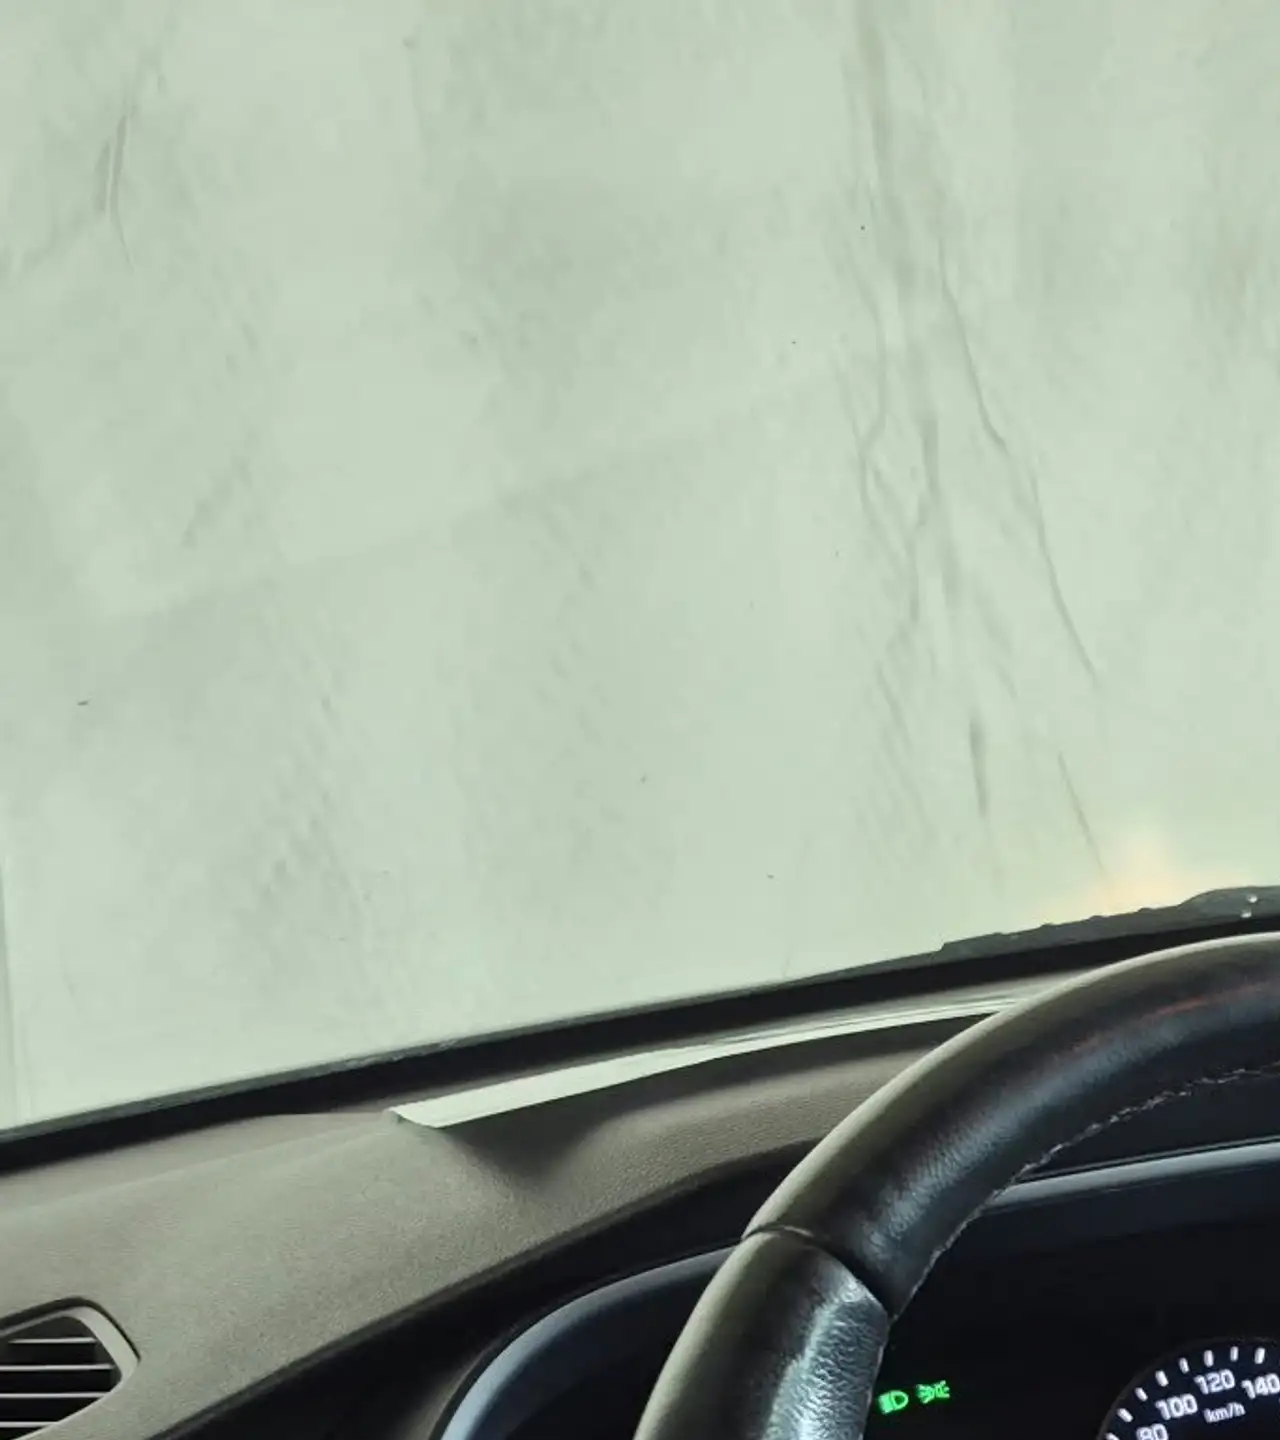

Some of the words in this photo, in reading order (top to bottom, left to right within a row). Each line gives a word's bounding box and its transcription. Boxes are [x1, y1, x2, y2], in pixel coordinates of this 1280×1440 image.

[1195, 1368, 1236, 1395] 120
[1156, 1394, 1198, 1421] 100
[1204, 1402, 1246, 1423] km/h
